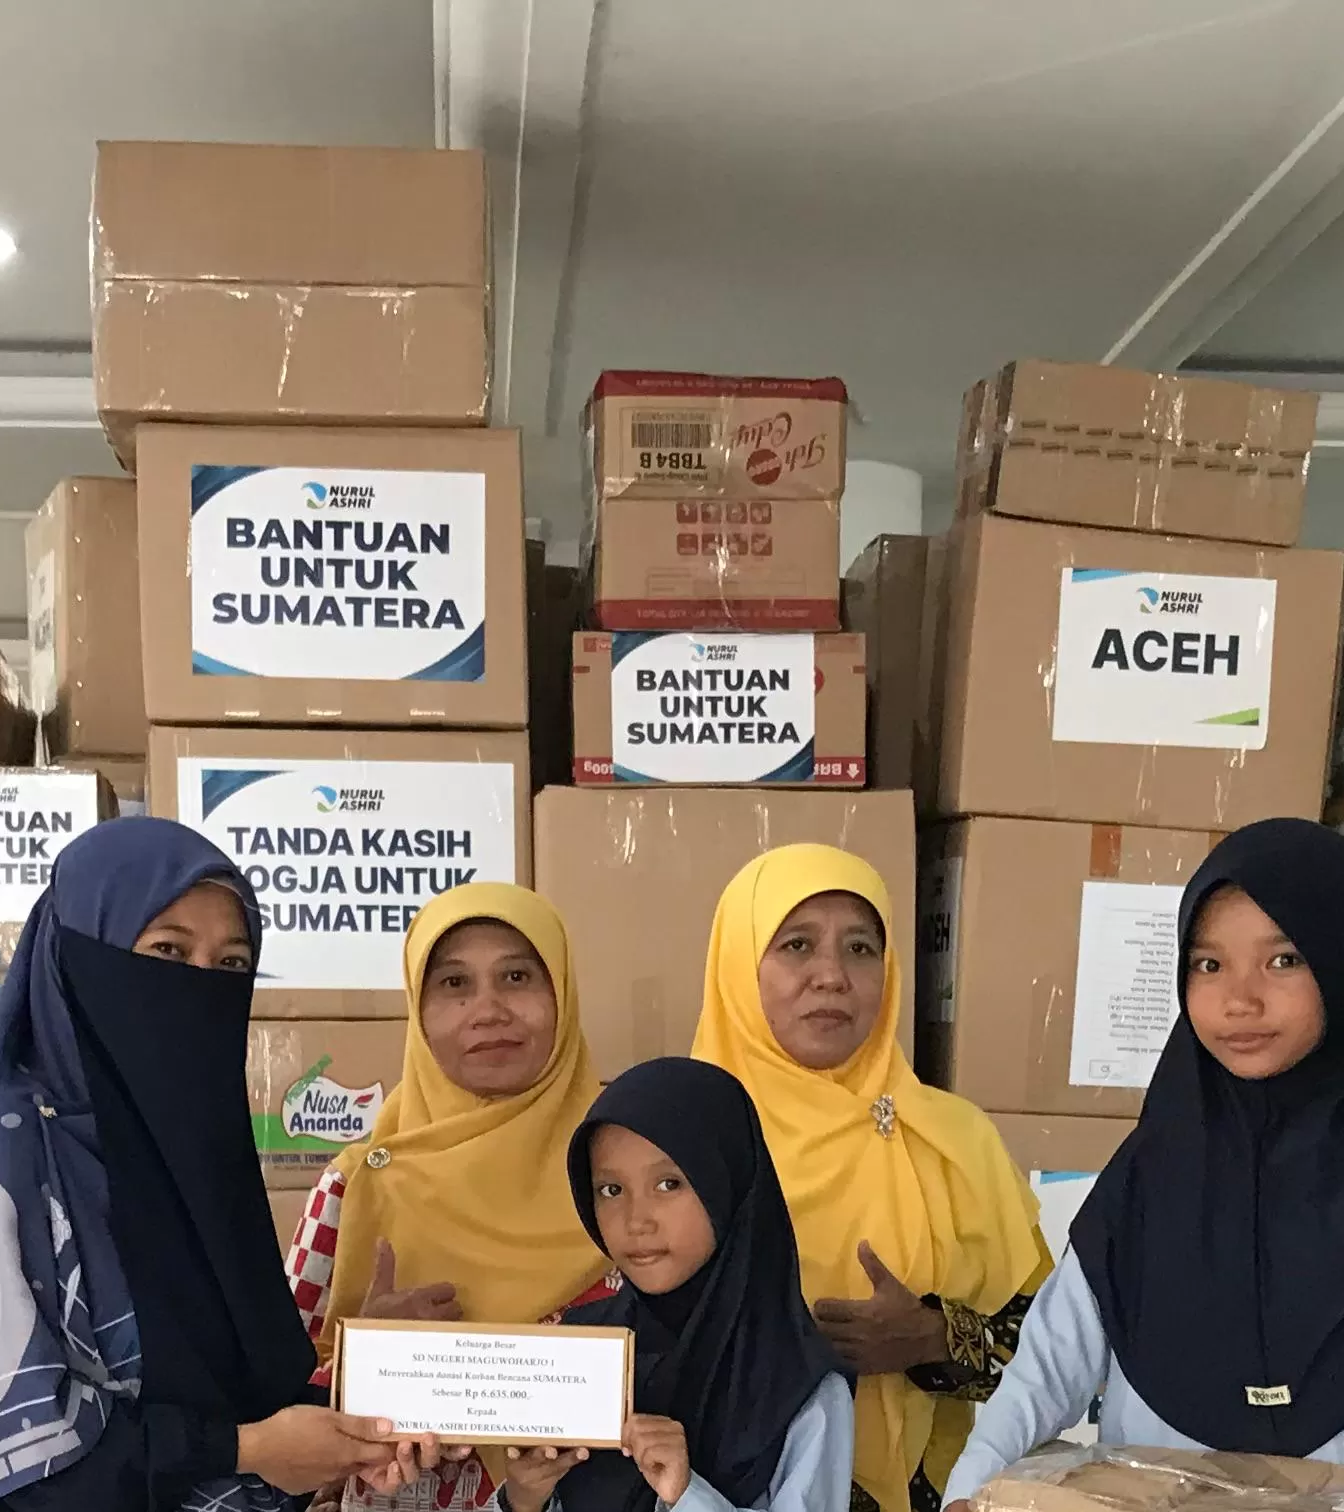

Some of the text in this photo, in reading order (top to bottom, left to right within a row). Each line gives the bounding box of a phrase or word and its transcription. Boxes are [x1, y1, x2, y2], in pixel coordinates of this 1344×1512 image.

[656, 452, 707, 470] TBB4
[329, 485, 375, 498] NURUL
[329, 496, 372, 509] ASHRI
[226, 517, 450, 555] BANTUAN
[260, 556, 417, 591] UNTUK
[1161, 591, 1203, 604] NURUL
[212, 592, 465, 630] SUMATERA
[1160, 602, 1199, 614] ASHRI
[706, 644, 738, 654] NURUL
[1091, 629, 1240, 677] ACEH
[706, 652, 736, 662] ASHRI
[636, 669, 790, 692] BANTUAN
[660, 696, 767, 718] UNTUK
[627, 722, 800, 744] SUMATERA
[339, 788, 385, 801] NURUL
[339, 799, 381, 812] ASHRI
[227, 826, 472, 858] TANDA KASIH
[238, 865, 347, 895] OGJA
[258, 903, 420, 933] SUMATE
[290, 1112, 363, 1132] Ananda
[455, 1339, 516, 1350] Keluarga Besar
[412, 1353, 425, 1362] SD
[427, 1354, 465, 1364] NEGERI
[467, 1356, 549, 1367] MAGUWOHARJO
[465, 1371, 495, 1381] Korban
[497, 1373, 531, 1382] Bencana
[533, 1374, 587, 1384] SUMATERA
[465, 1389, 479, 1400] Rp
[467, 1407, 497, 1417] Kepada
[397, 1420, 433, 1430] NURUL
